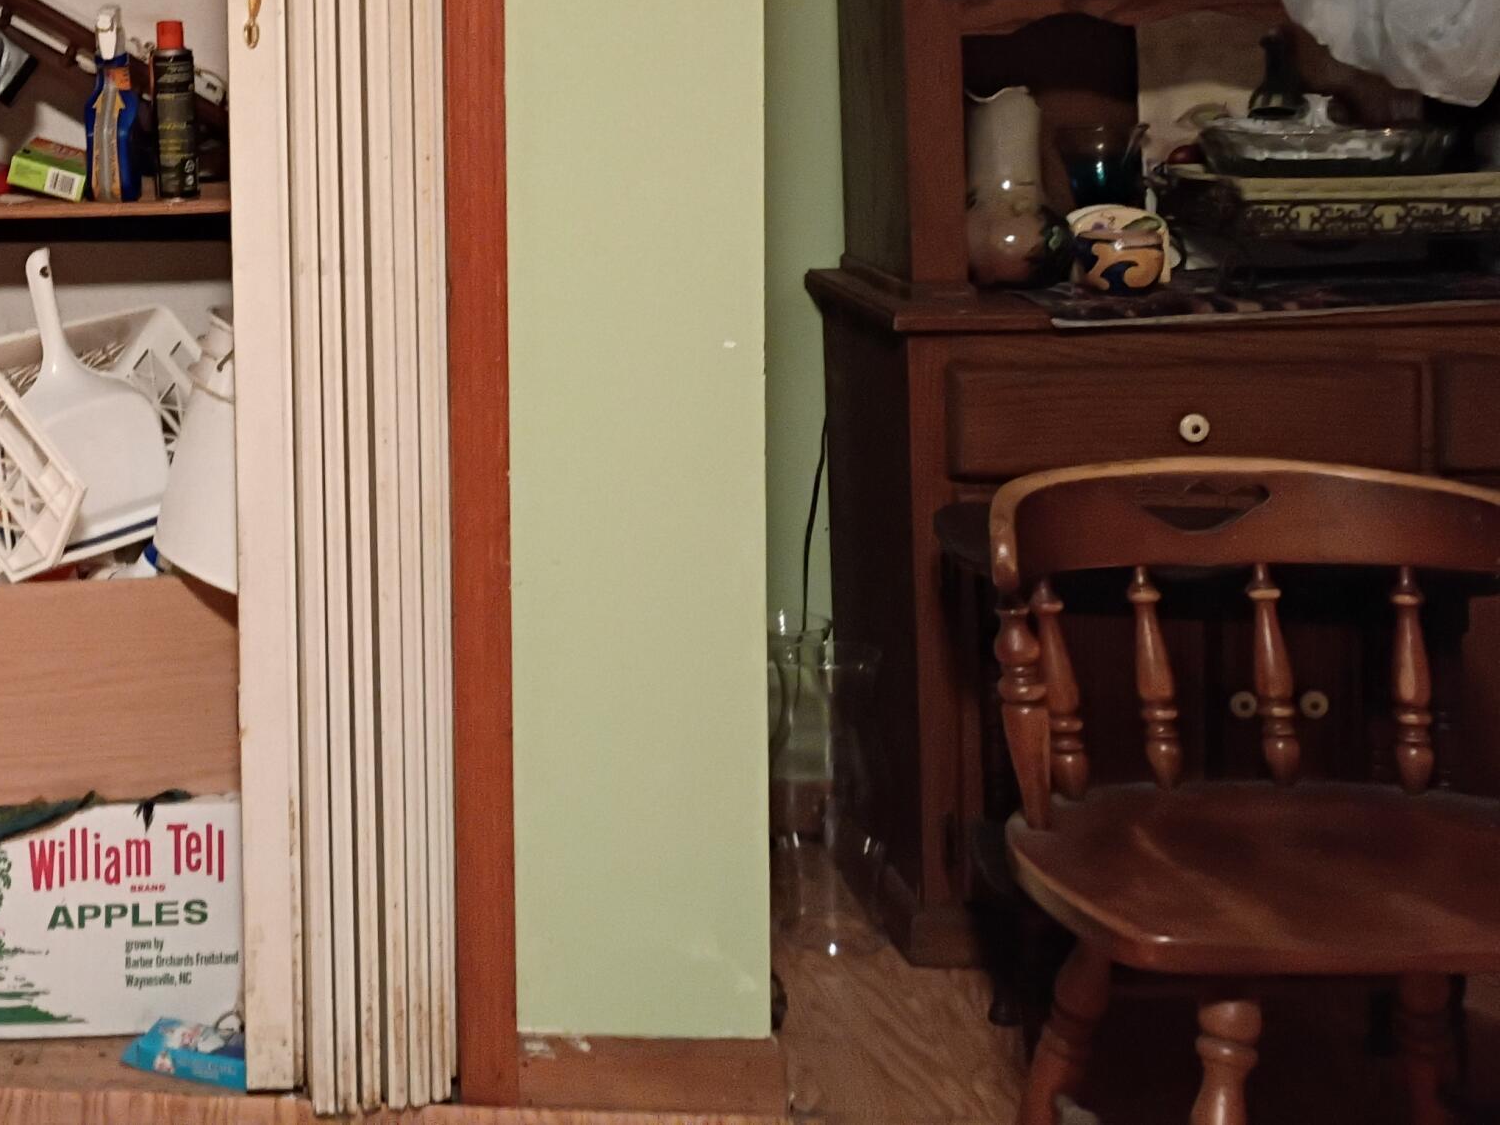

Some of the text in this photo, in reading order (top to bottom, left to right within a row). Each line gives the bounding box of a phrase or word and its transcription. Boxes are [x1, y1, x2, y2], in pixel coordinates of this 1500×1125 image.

[29, 823, 225, 892] William Tell
[130, 883, 166, 893] BRAND
[47, 899, 208, 931] APPLES
[125, 937, 164, 953] grown by
[155, 953, 194, 967] Orchards
[179, 971, 192, 985] NC
